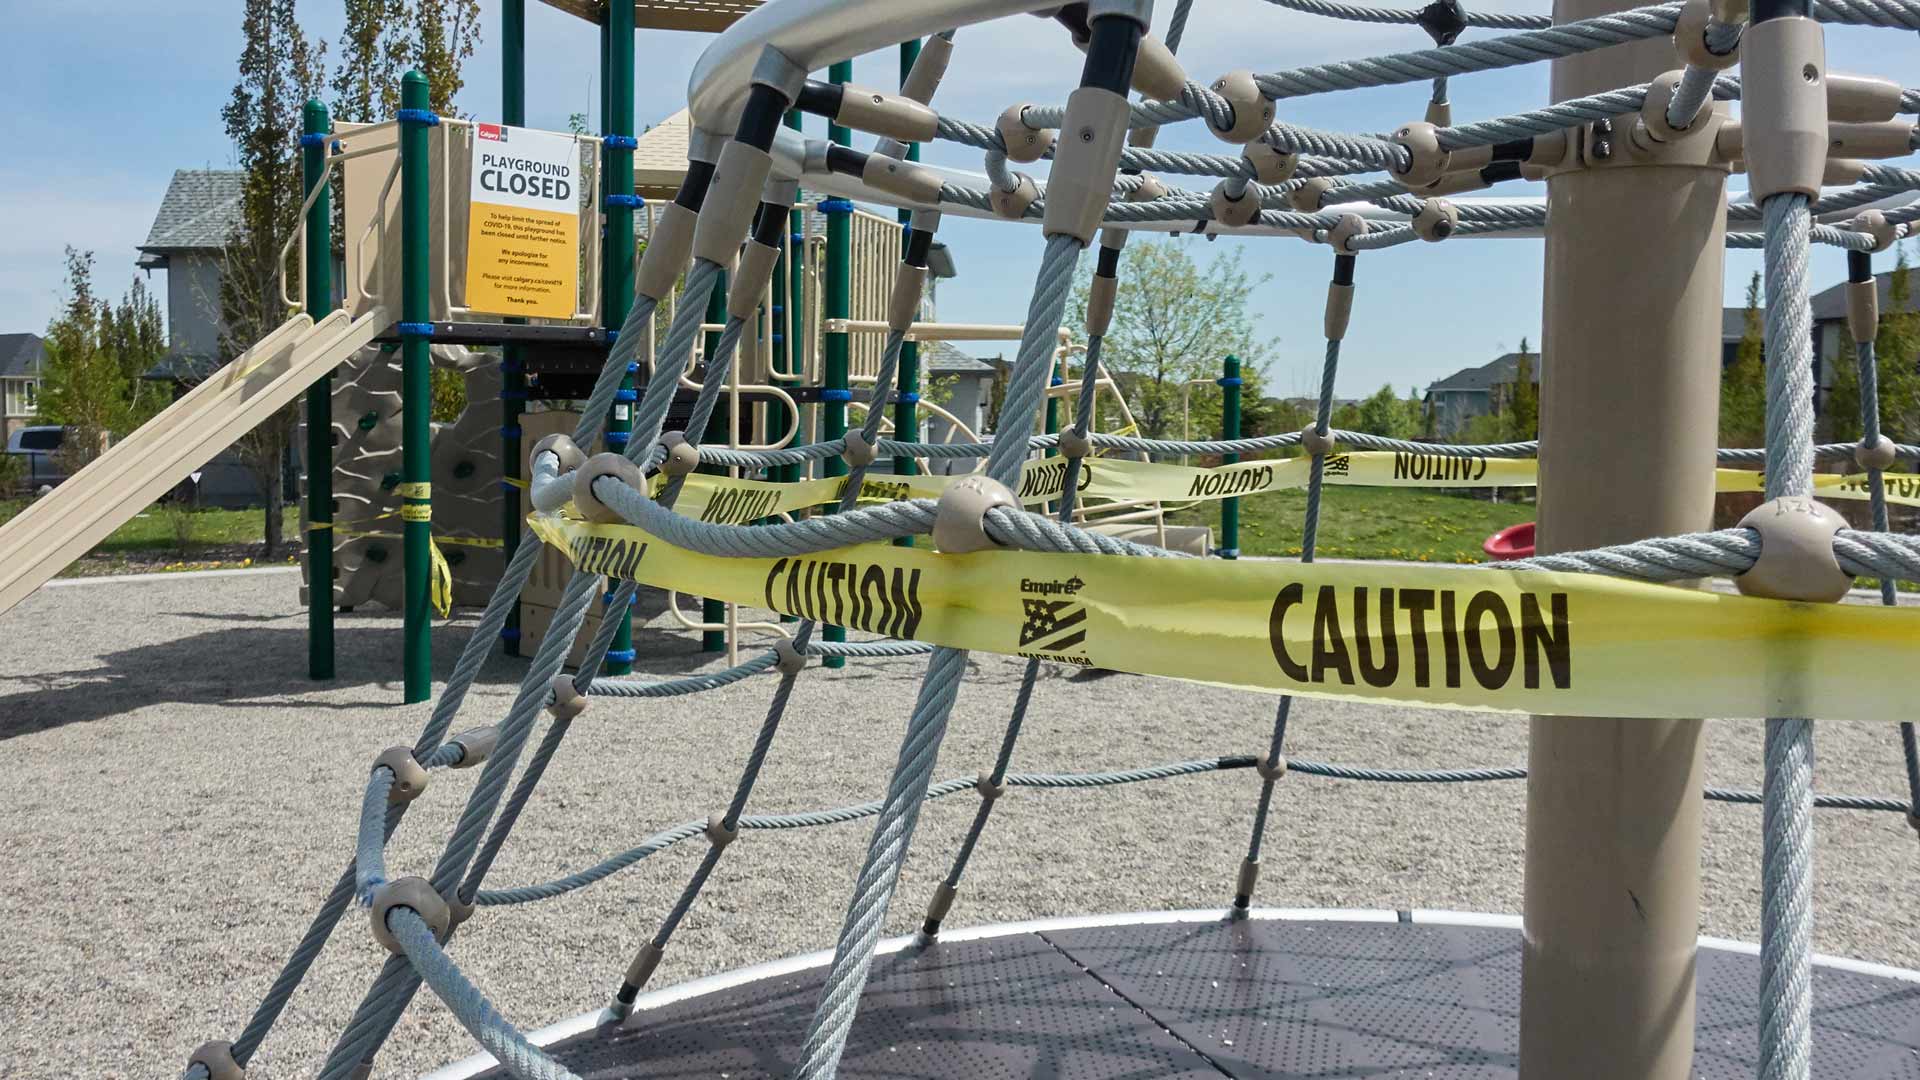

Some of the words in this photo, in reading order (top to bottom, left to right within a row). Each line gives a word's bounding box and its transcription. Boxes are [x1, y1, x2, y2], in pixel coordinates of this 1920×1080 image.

[480, 129, 499, 140] Calgary
[482, 153, 570, 178] PLAYGROUND
[480, 169, 571, 201] CLOSED
[497, 231, 515, 239] closed
[524, 226, 555, 234] playground
[511, 250, 538, 259] apologize
[1395, 453, 1487, 481] CAUTION
[1018, 463, 1092, 498] CUTION
[1188, 465, 1274, 497] CAUTION
[765, 557, 922, 641] CAUTION
[1020, 577, 1076, 596] Empire
[1269, 582, 1571, 690] CAUTION
[1068, 656, 1094, 666] USA
